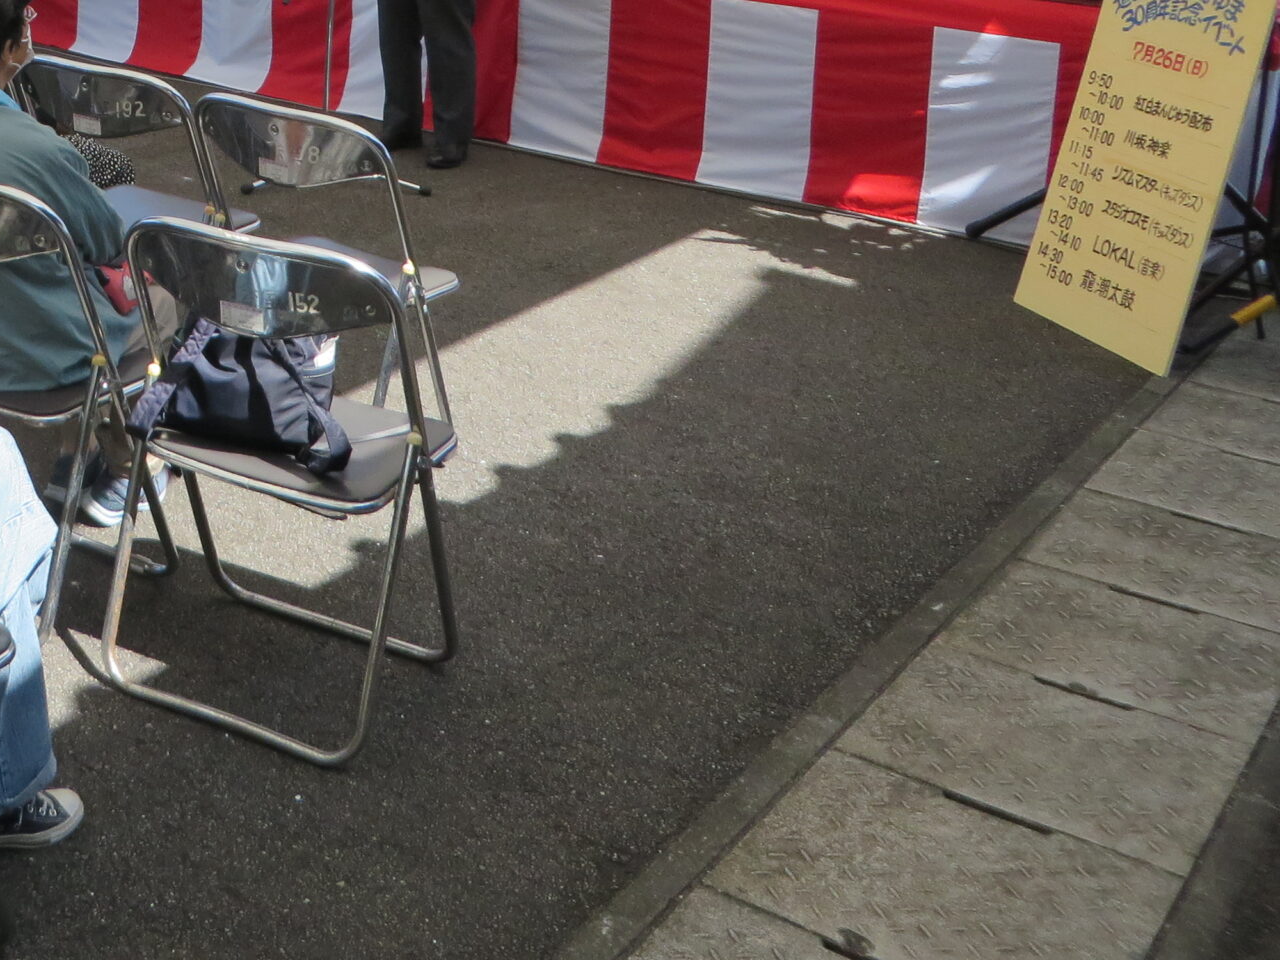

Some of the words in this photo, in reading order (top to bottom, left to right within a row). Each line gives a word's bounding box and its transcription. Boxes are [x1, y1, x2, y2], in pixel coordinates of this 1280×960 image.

[1088, 70, 1113, 89] 9:50
[116, 101, 146, 118] 192
[1079, 106, 1105, 126] 10:00
[1133, 95, 1214, 133] 紅白まんじゅう配布
[1069, 140, 1093, 159] 11:15
[1048, 208, 1073, 230] 13:20
[1038, 241, 1064, 264] 14:30
[288, 291, 320, 314] 152
